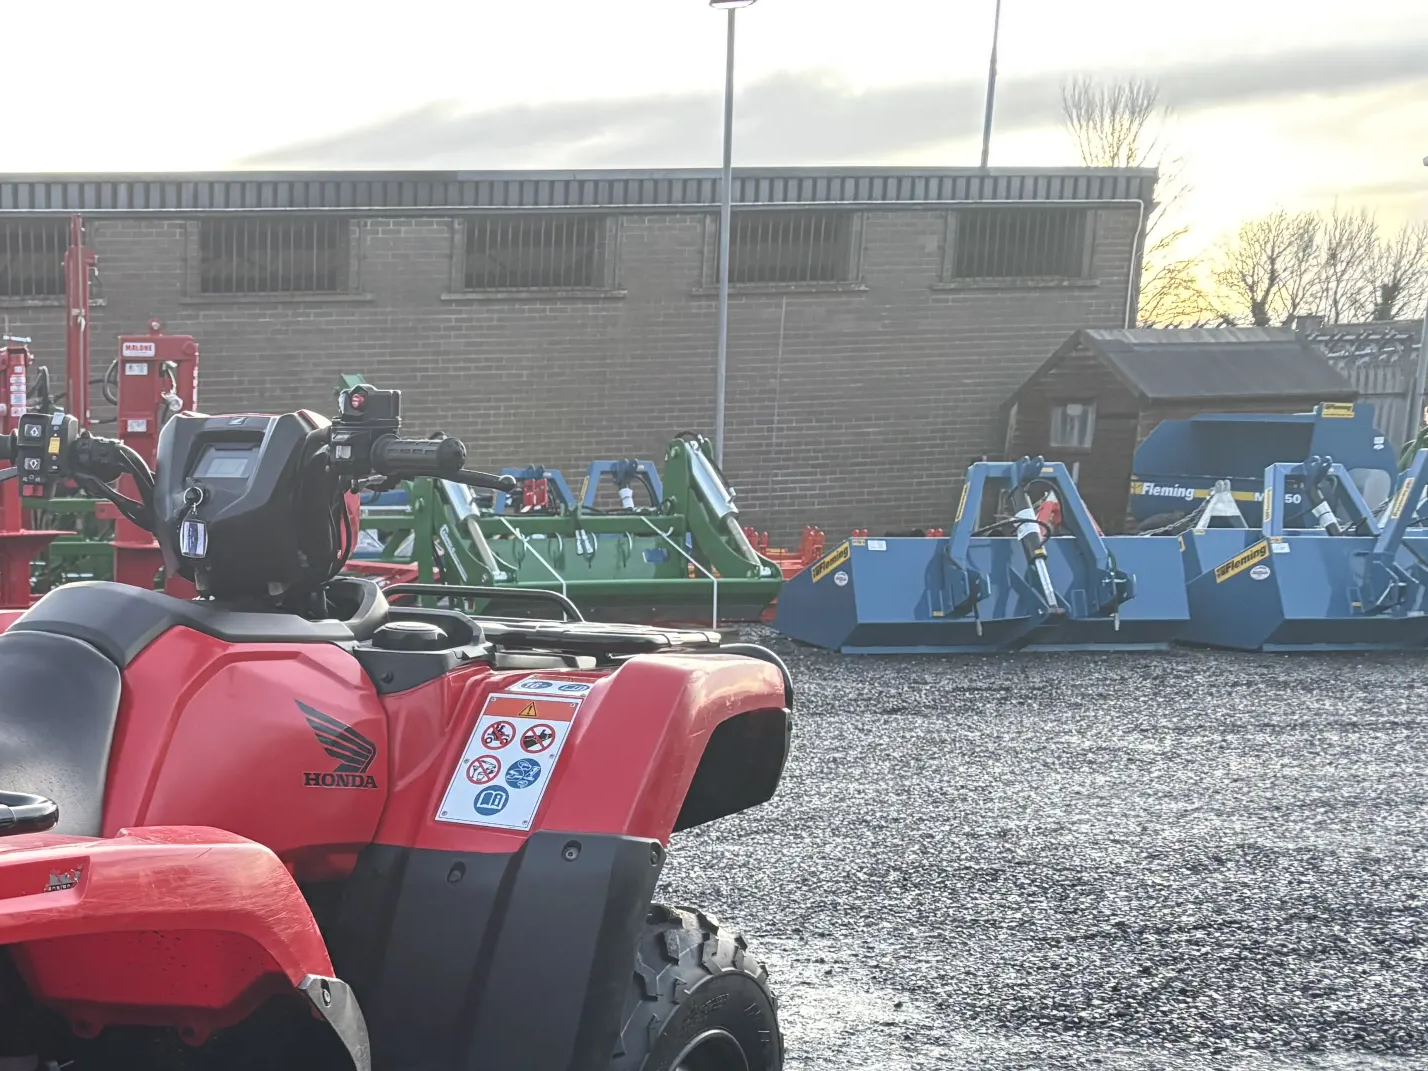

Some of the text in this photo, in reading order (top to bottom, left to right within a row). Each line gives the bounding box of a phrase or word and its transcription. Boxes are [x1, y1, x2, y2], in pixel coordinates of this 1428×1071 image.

[1142, 482, 1195, 501] Fleming
[819, 546, 849, 573] Fleming
[1225, 545, 1267, 575] Fleming
[303, 772, 378, 788] HONDA
